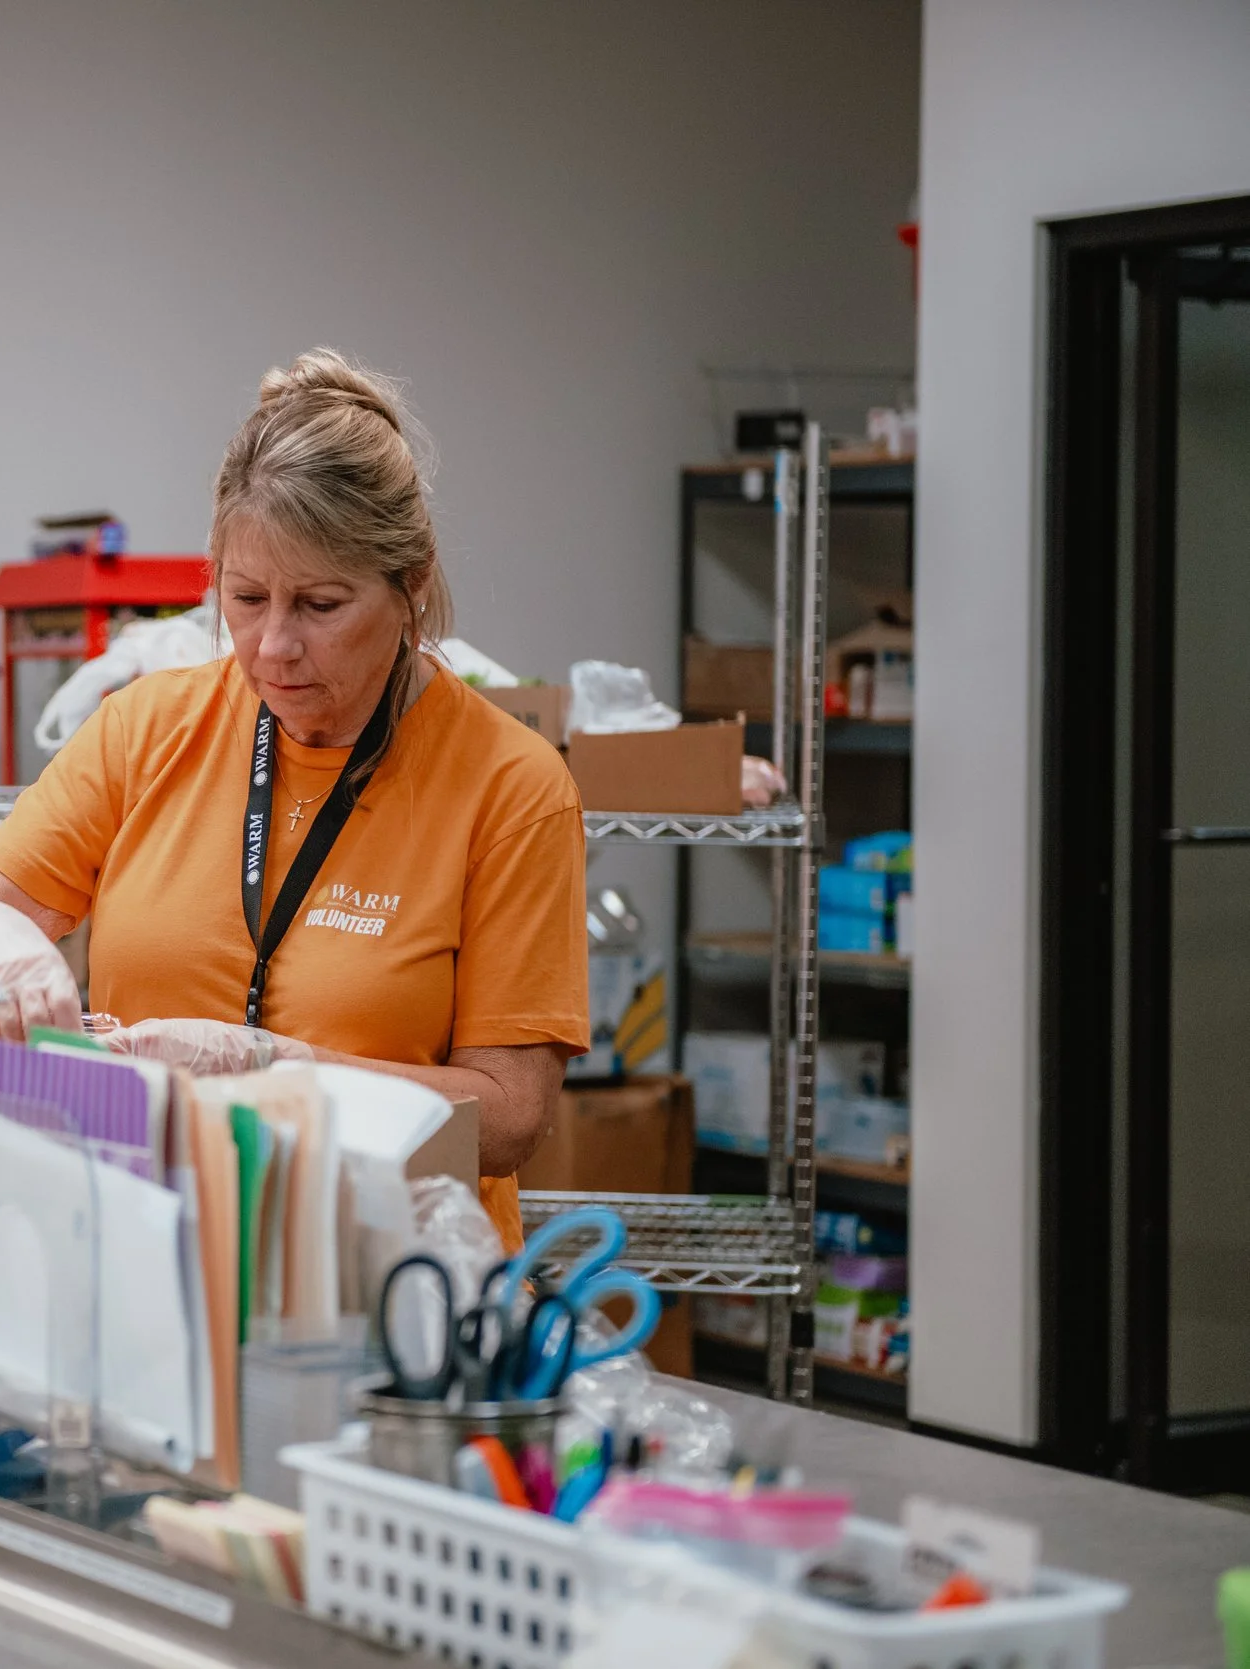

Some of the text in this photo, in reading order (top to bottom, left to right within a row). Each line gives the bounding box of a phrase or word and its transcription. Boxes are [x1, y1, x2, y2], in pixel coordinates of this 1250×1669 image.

[255, 716, 270, 772] WARM
[248, 813, 263, 871] WARM
[332, 884, 401, 912] WARM
[305, 909, 386, 936] VOLUNTEER
